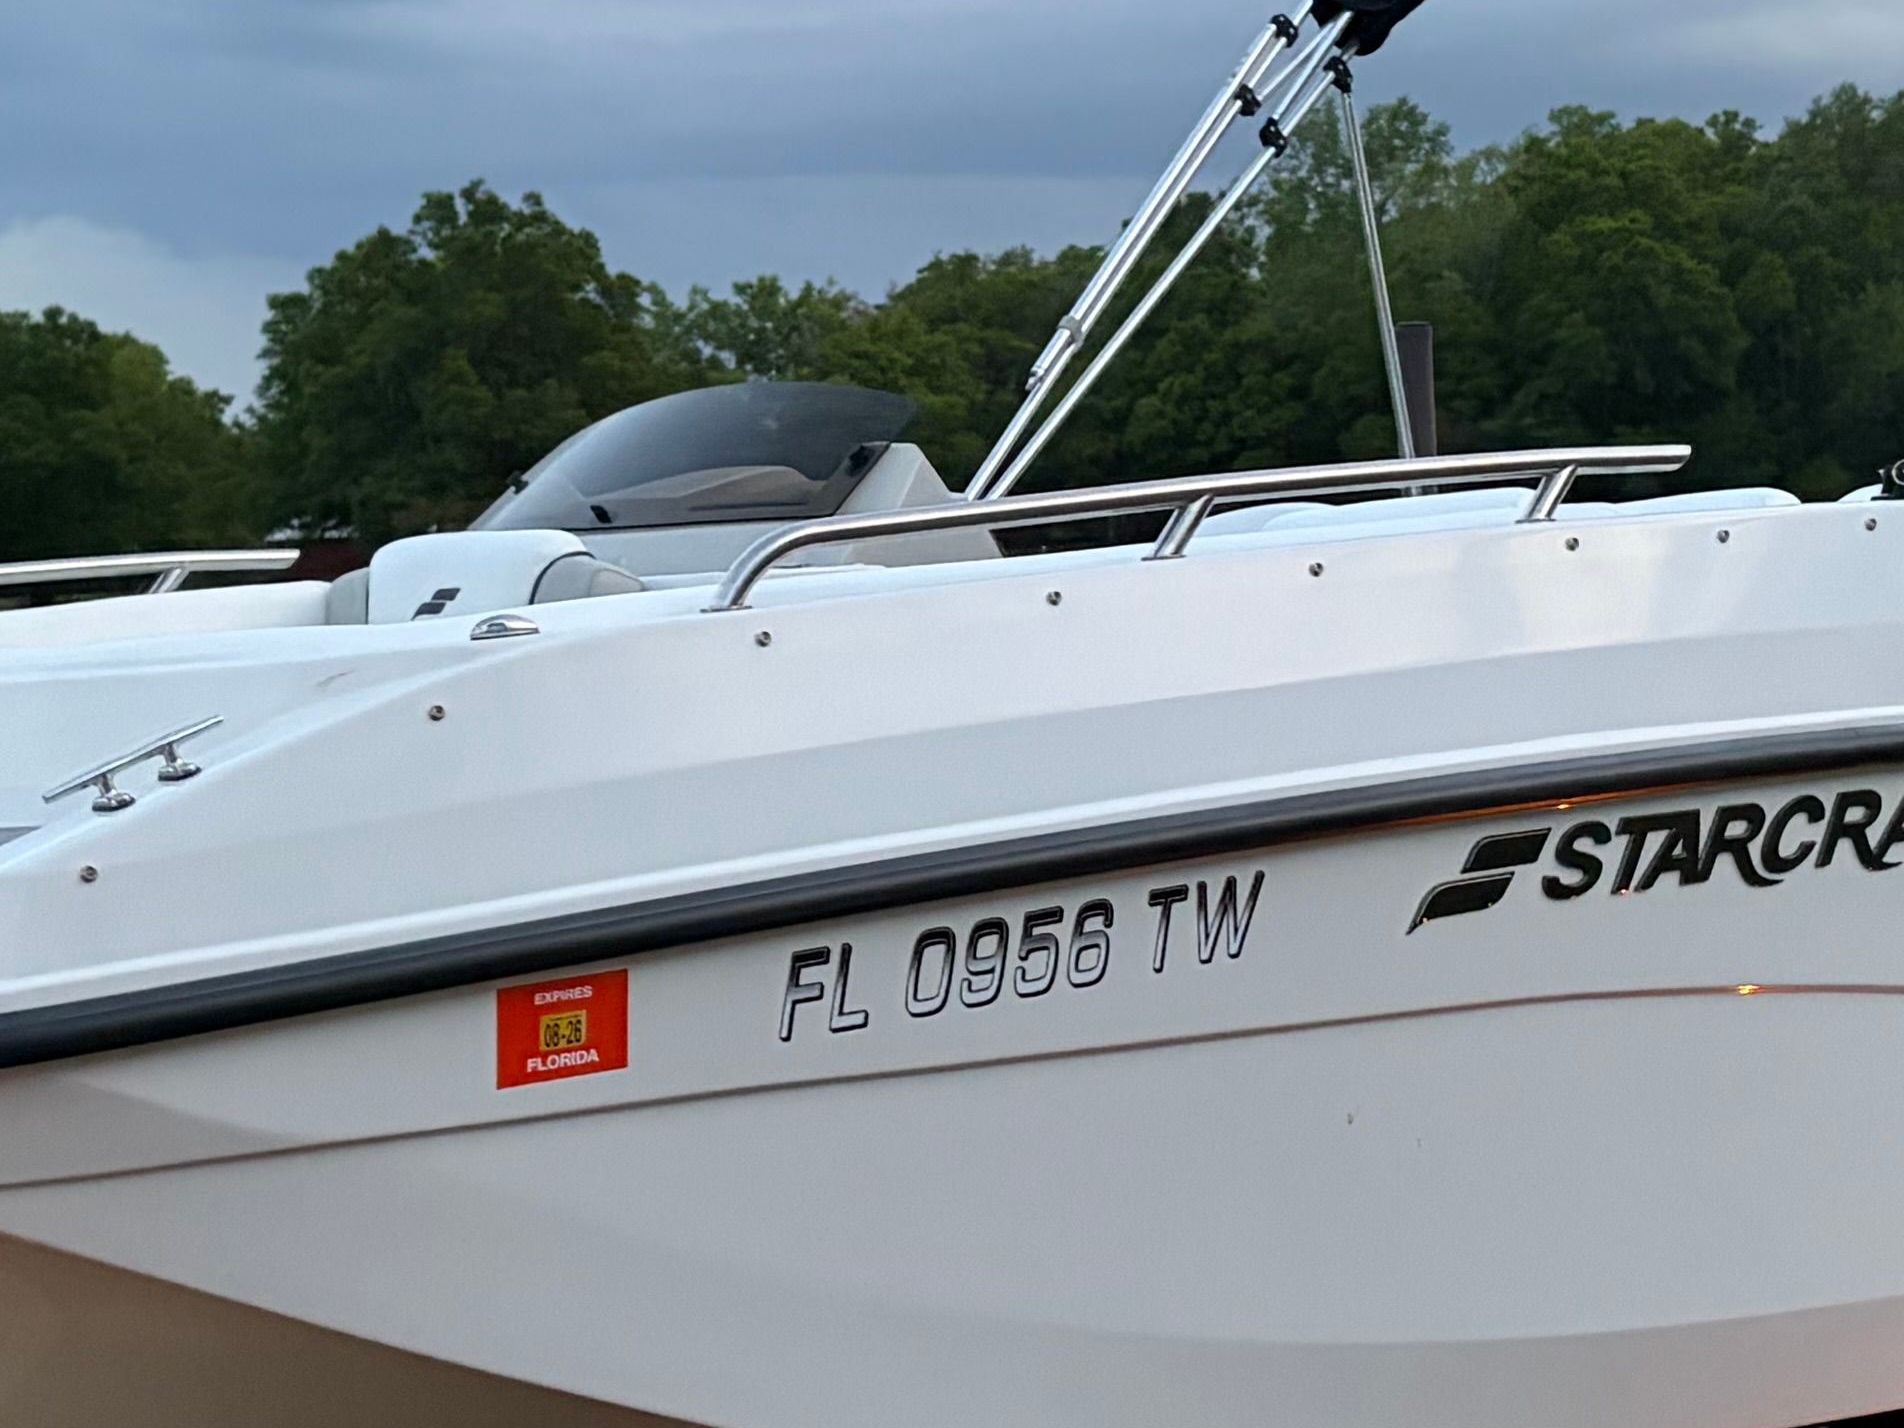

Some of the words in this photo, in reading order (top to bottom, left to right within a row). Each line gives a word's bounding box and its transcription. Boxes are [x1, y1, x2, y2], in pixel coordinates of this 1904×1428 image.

[778, 942, 870, 1042] FL
[904, 897, 1114, 1019] 0956
[1148, 869, 1265, 973] TW
[535, 986, 593, 1005] EXPIRES
[543, 1018, 583, 1048] 08-26
[527, 1049, 599, 1072] FLORIDA
